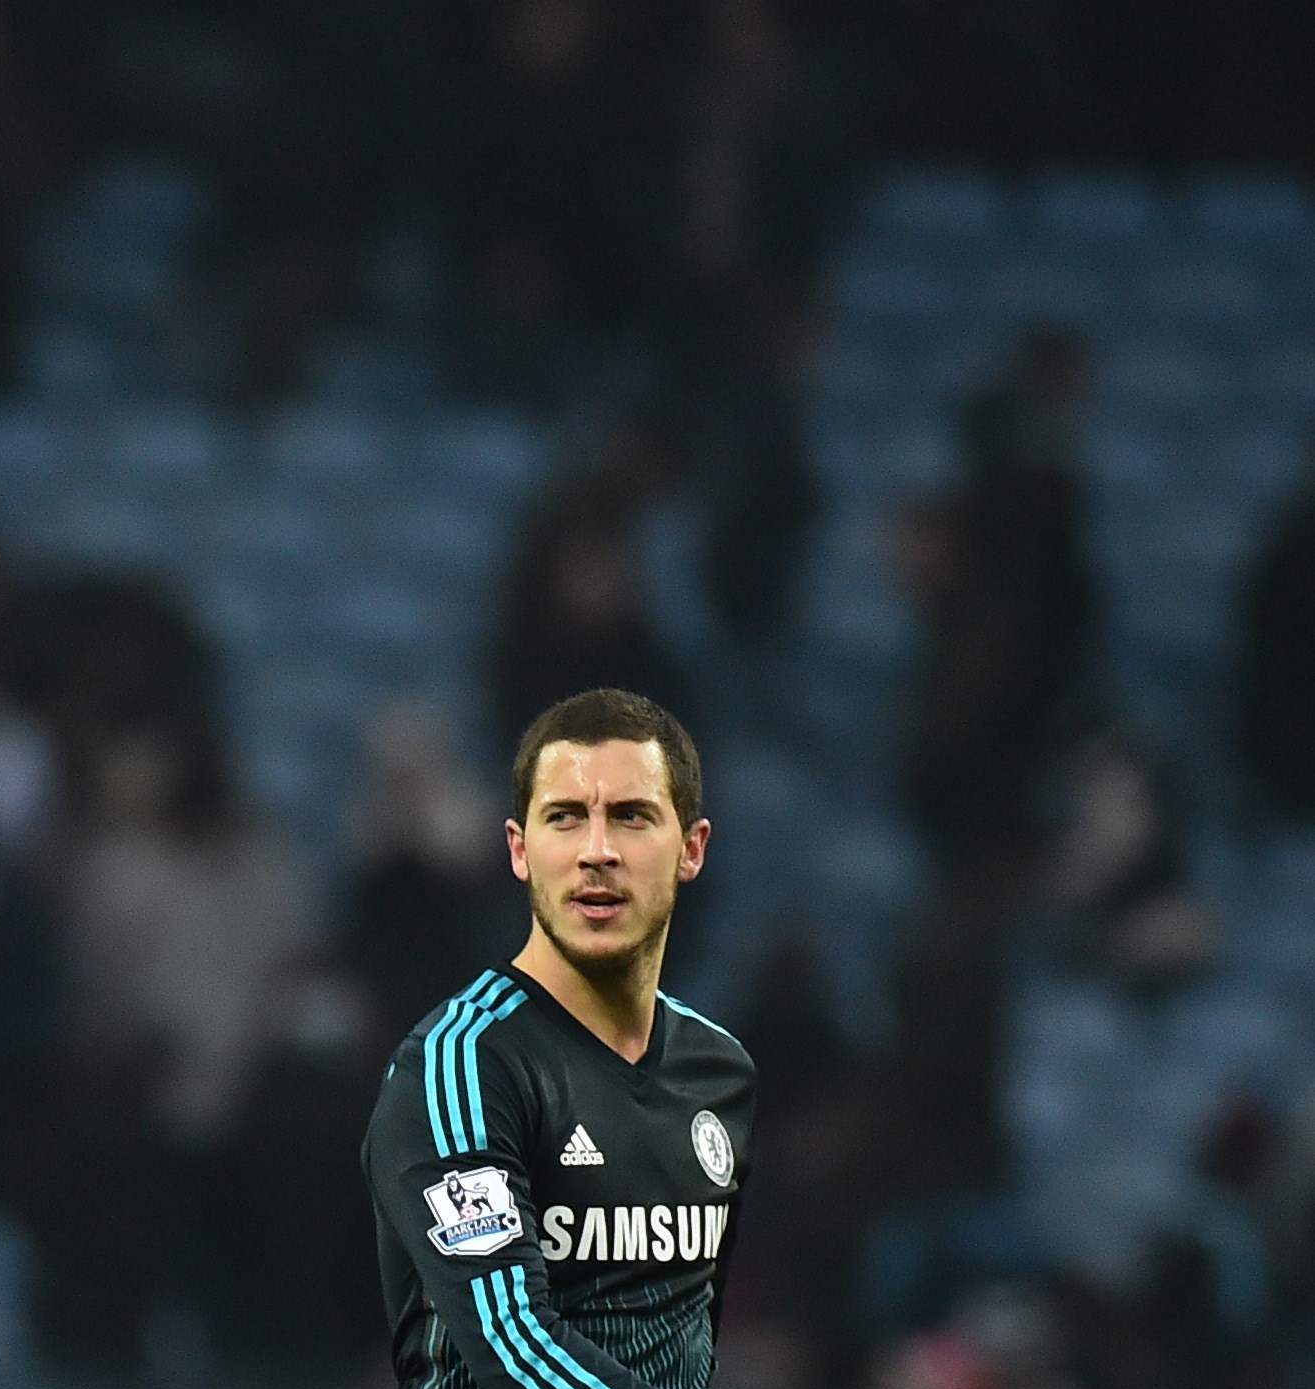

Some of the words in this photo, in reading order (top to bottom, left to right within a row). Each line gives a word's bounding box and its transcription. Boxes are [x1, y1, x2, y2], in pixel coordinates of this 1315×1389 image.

[559, 1150, 605, 1166] adidas
[445, 1215, 501, 1239] BARCLAYS
[540, 1203, 729, 1261] SAMSUN
